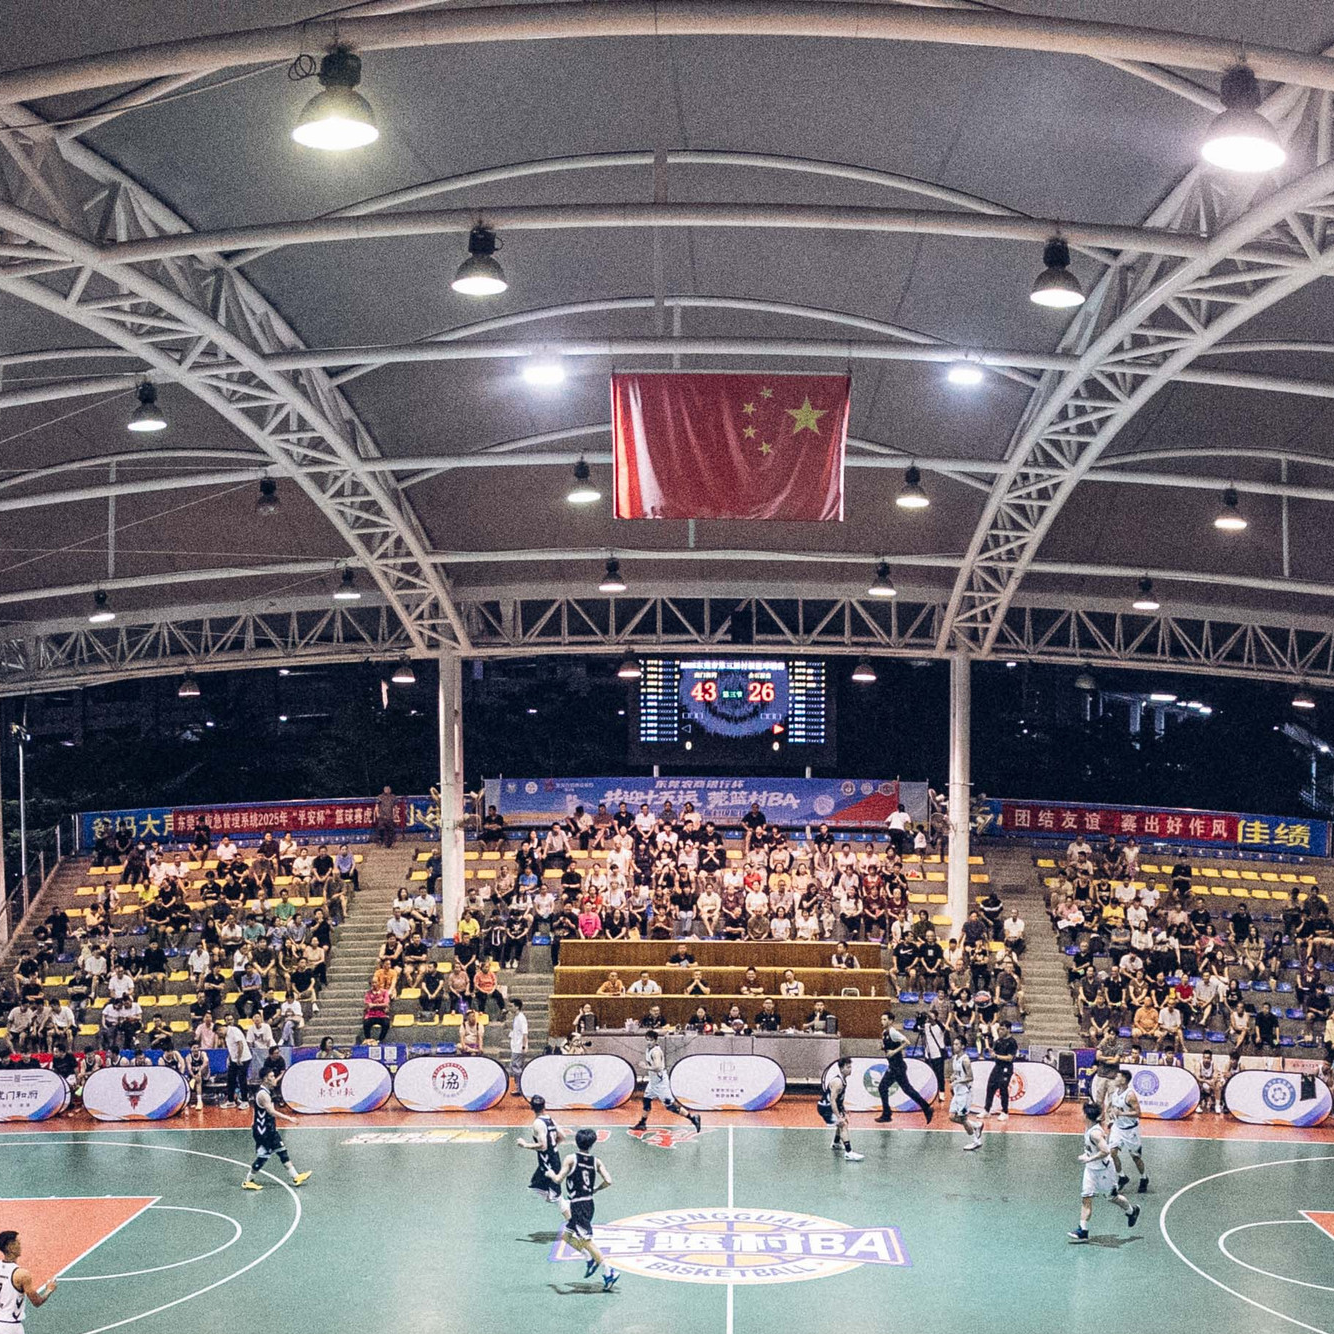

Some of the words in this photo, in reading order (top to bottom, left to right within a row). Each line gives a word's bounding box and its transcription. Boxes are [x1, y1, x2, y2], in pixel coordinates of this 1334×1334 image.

[691, 681, 717, 701] 43
[748, 682, 775, 701] 26
[1014, 808, 1102, 831] 团结友谊
[1120, 813, 1228, 838] 赛出好作风
[1237, 818, 1311, 848] 佳绩
[645, 1211, 817, 1229] DONGGUAN
[646, 1262, 816, 1279] BASKETBALL
